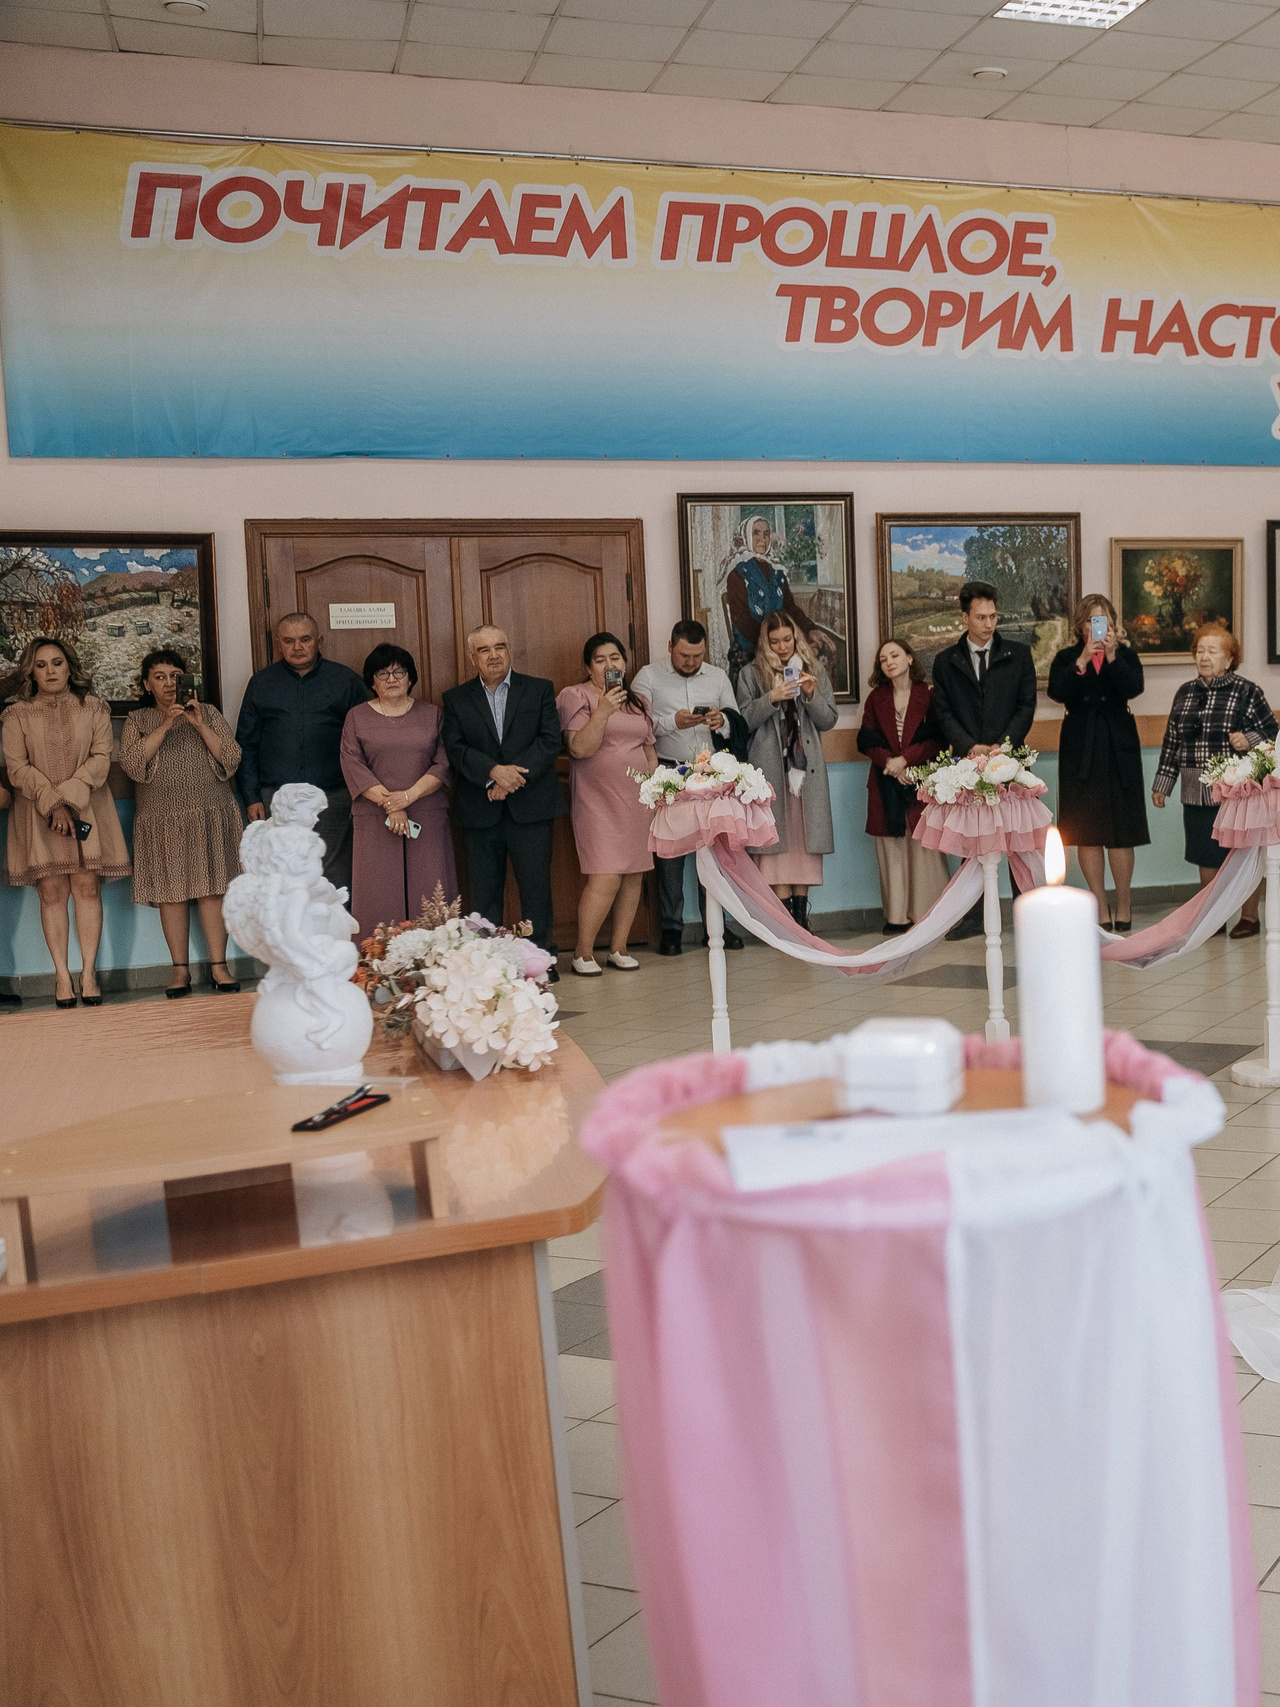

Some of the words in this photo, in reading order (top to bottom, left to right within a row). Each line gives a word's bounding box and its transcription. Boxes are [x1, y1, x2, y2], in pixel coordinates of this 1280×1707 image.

[130, 171, 629, 260] ПОЧИТАЕМ
[660, 200, 1057, 287] ПРОШЛОЕ,
[775, 283, 1074, 353] ТВОРИМ
